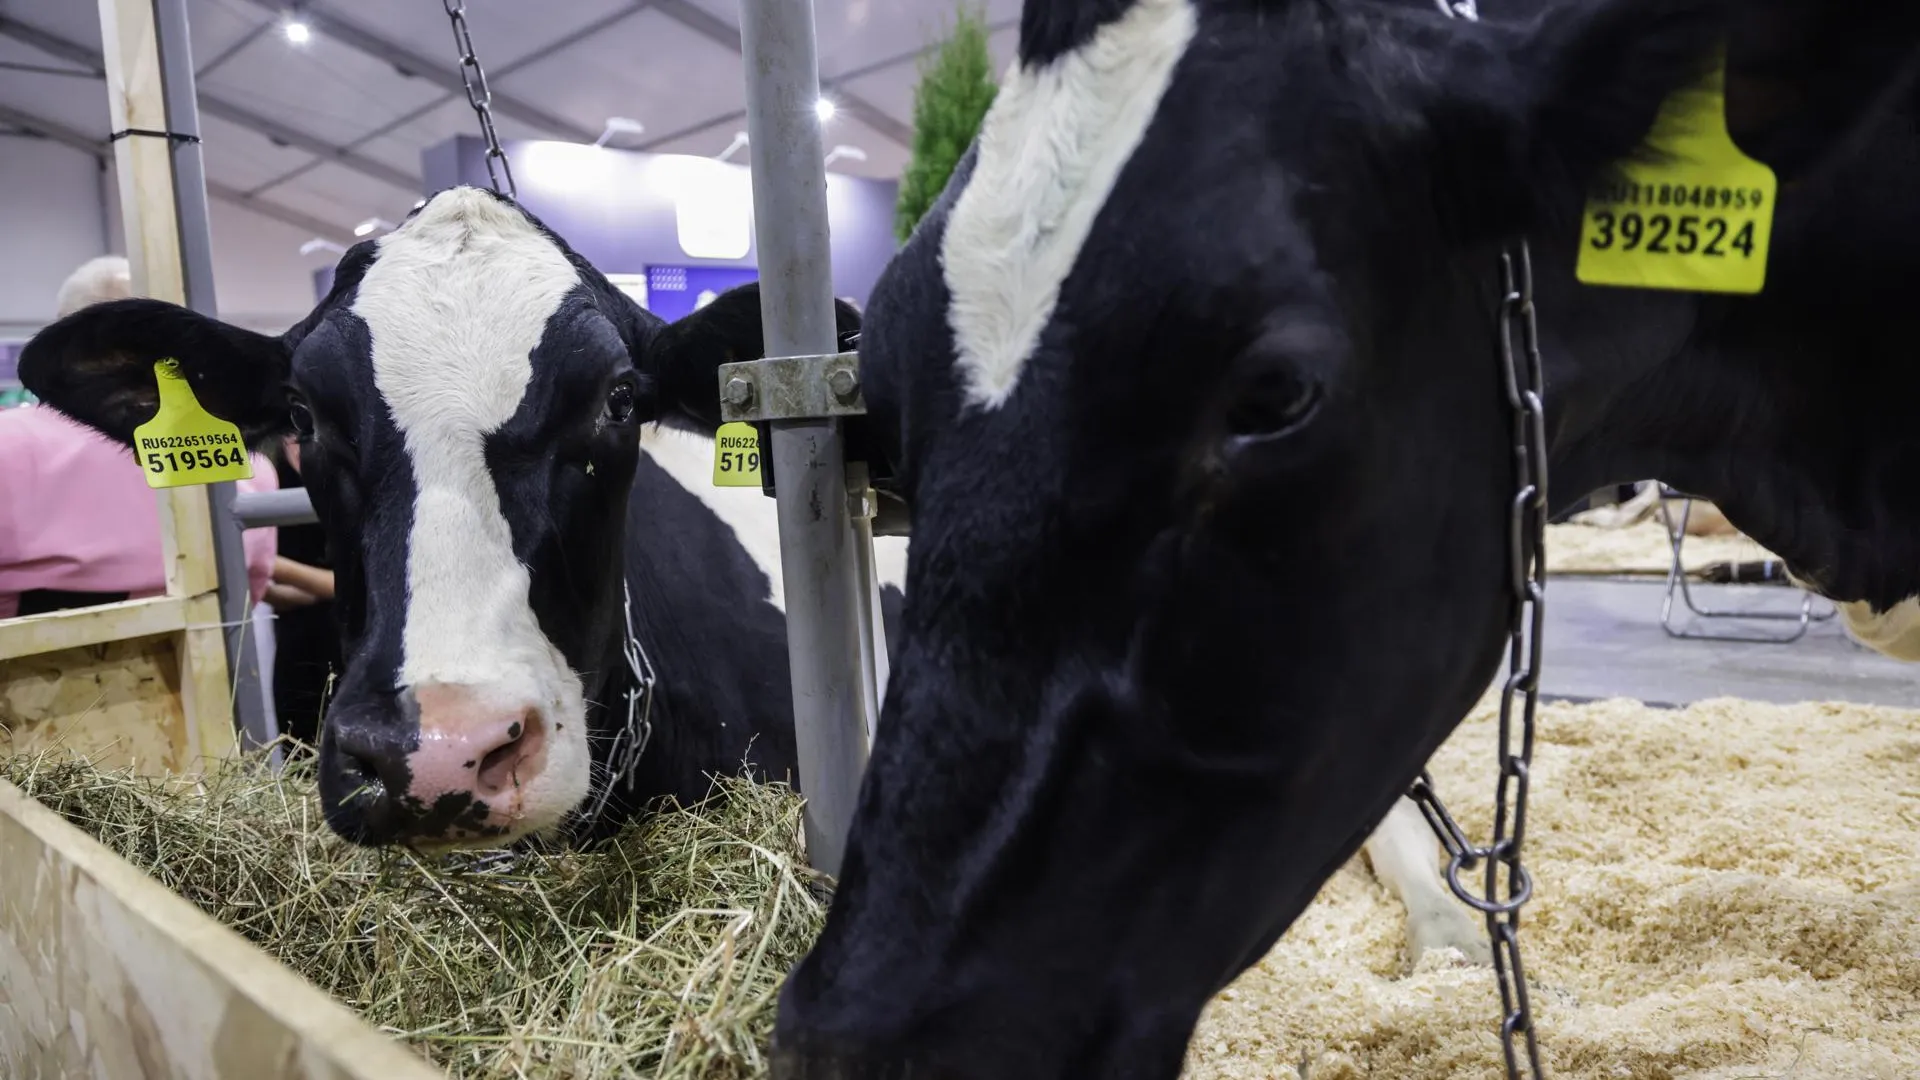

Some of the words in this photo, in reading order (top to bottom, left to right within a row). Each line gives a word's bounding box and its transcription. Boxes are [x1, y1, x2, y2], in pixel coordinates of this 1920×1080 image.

[1593, 183, 1763, 209] U118048959
[1590, 211, 1755, 258] 392524
[142, 433, 238, 449] RU6226519564
[148, 447, 244, 473] 519564
[720, 452, 759, 472] 519
